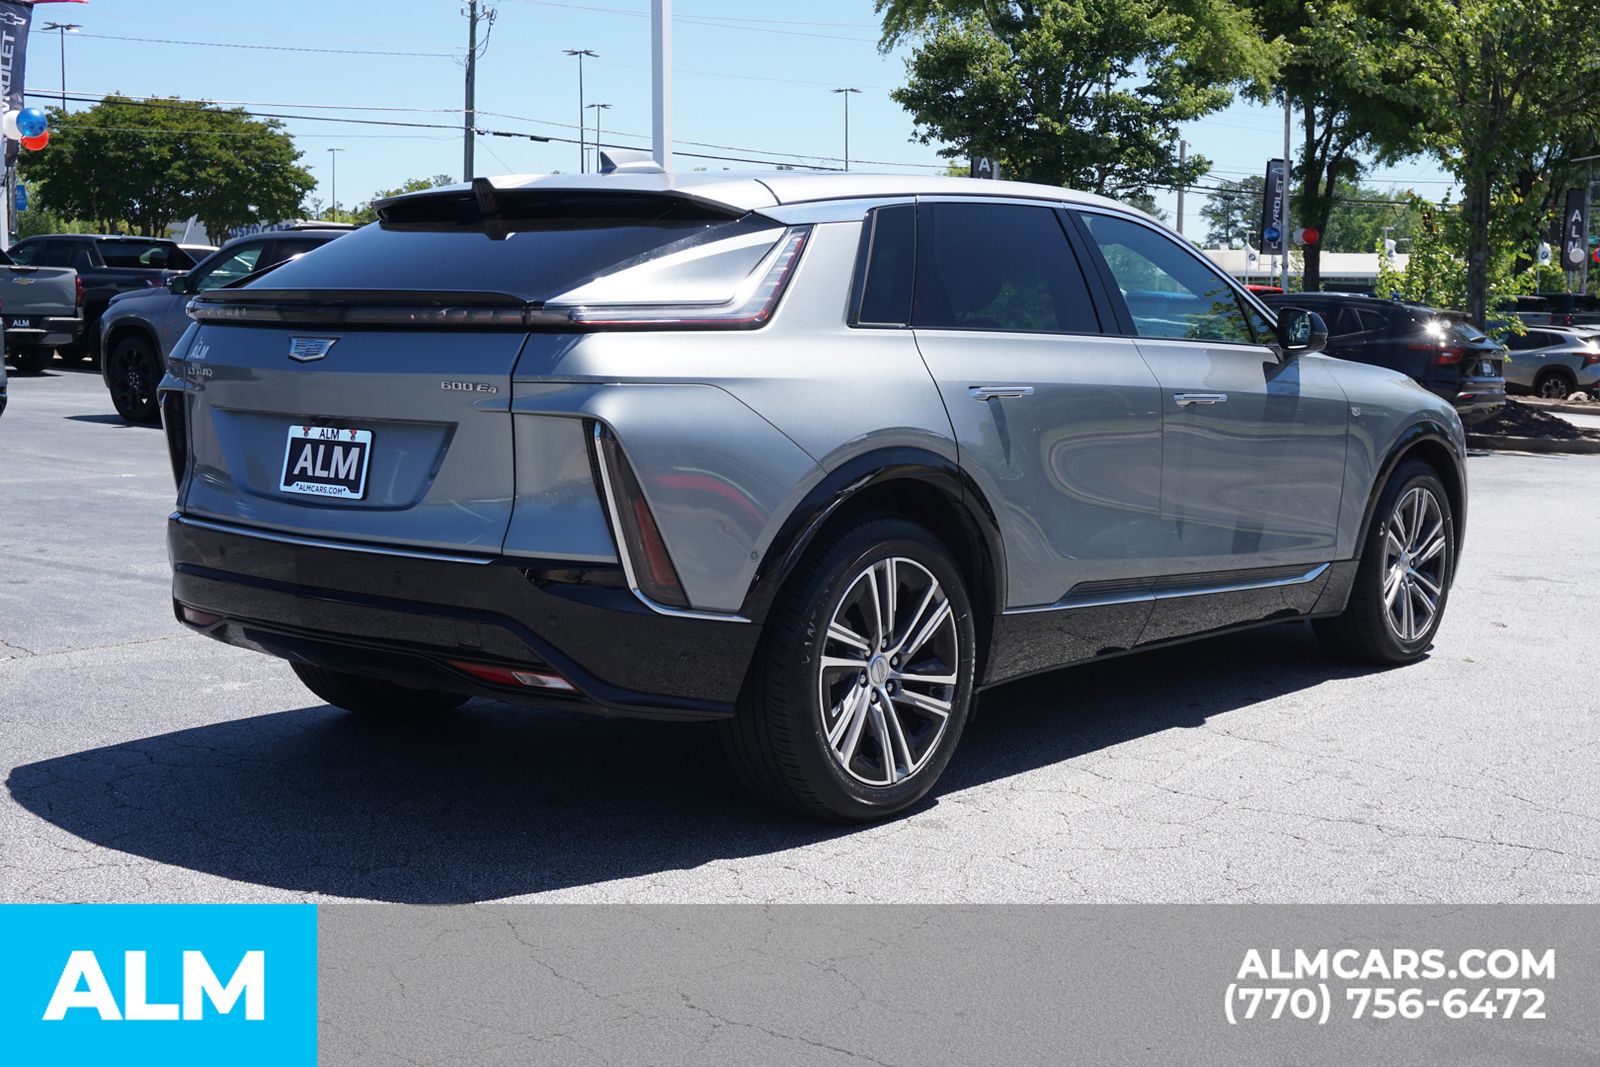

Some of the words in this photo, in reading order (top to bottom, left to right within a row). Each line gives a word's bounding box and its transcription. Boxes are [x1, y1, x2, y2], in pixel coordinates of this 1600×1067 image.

[12, 319, 30, 327] ALM
[441, 381, 473, 391] 600
[319, 428, 340, 440] ALM
[292, 443, 360, 480] ALM
[298, 484, 343, 495] ALMCARS.COM
